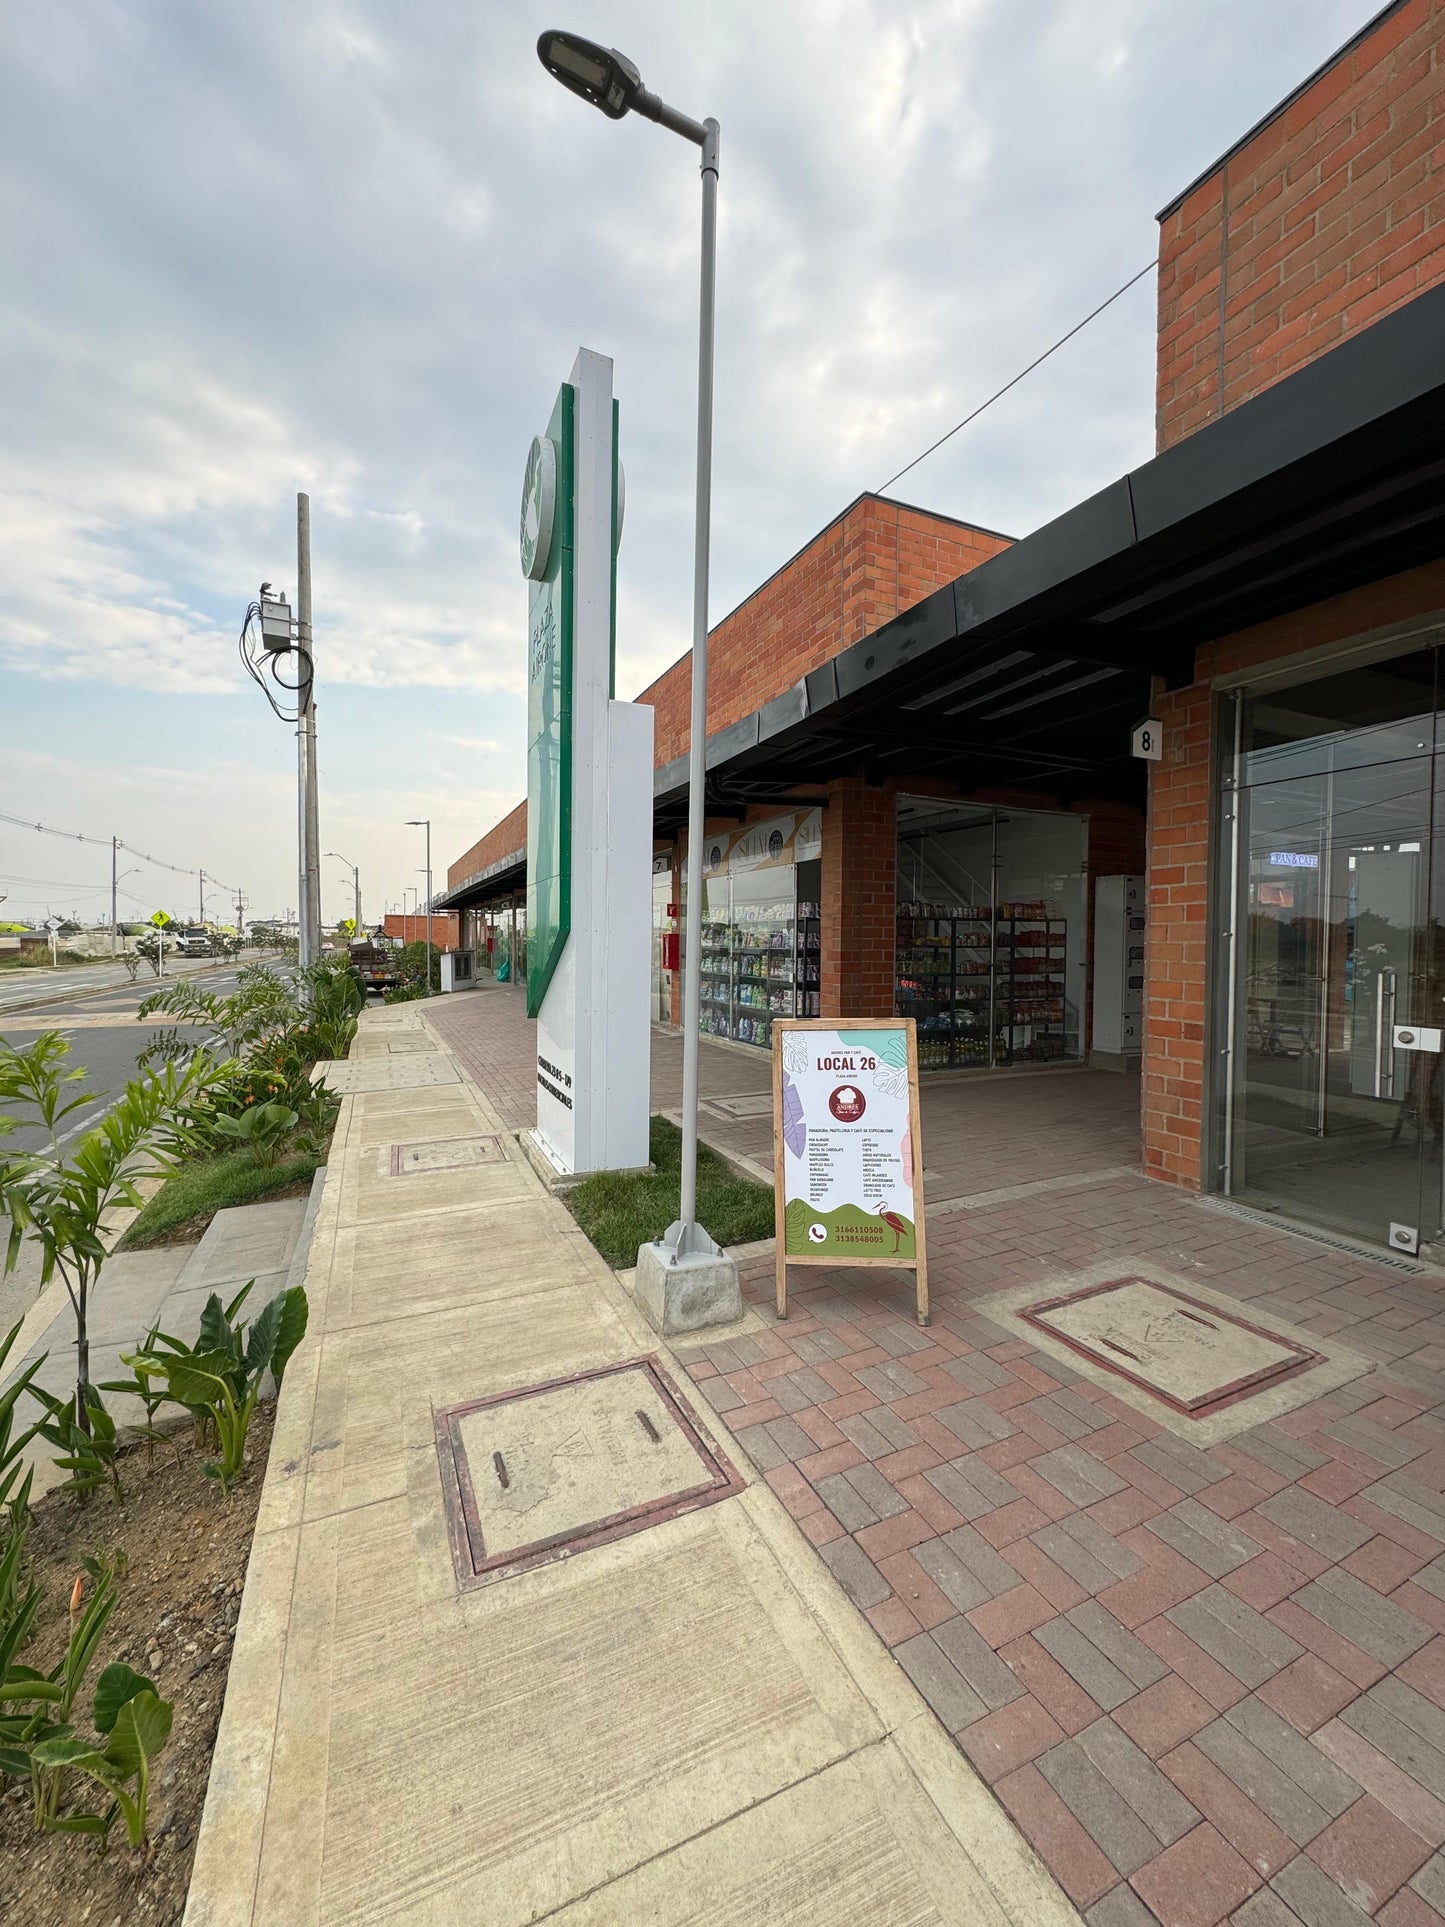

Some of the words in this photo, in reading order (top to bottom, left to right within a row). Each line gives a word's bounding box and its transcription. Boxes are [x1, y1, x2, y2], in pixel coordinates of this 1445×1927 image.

[1142, 730, 1150, 752] 8
[656, 861, 662, 870] 7
[817, 1057, 856, 1070] LOCAL
[860, 1057, 876, 1070] 26
